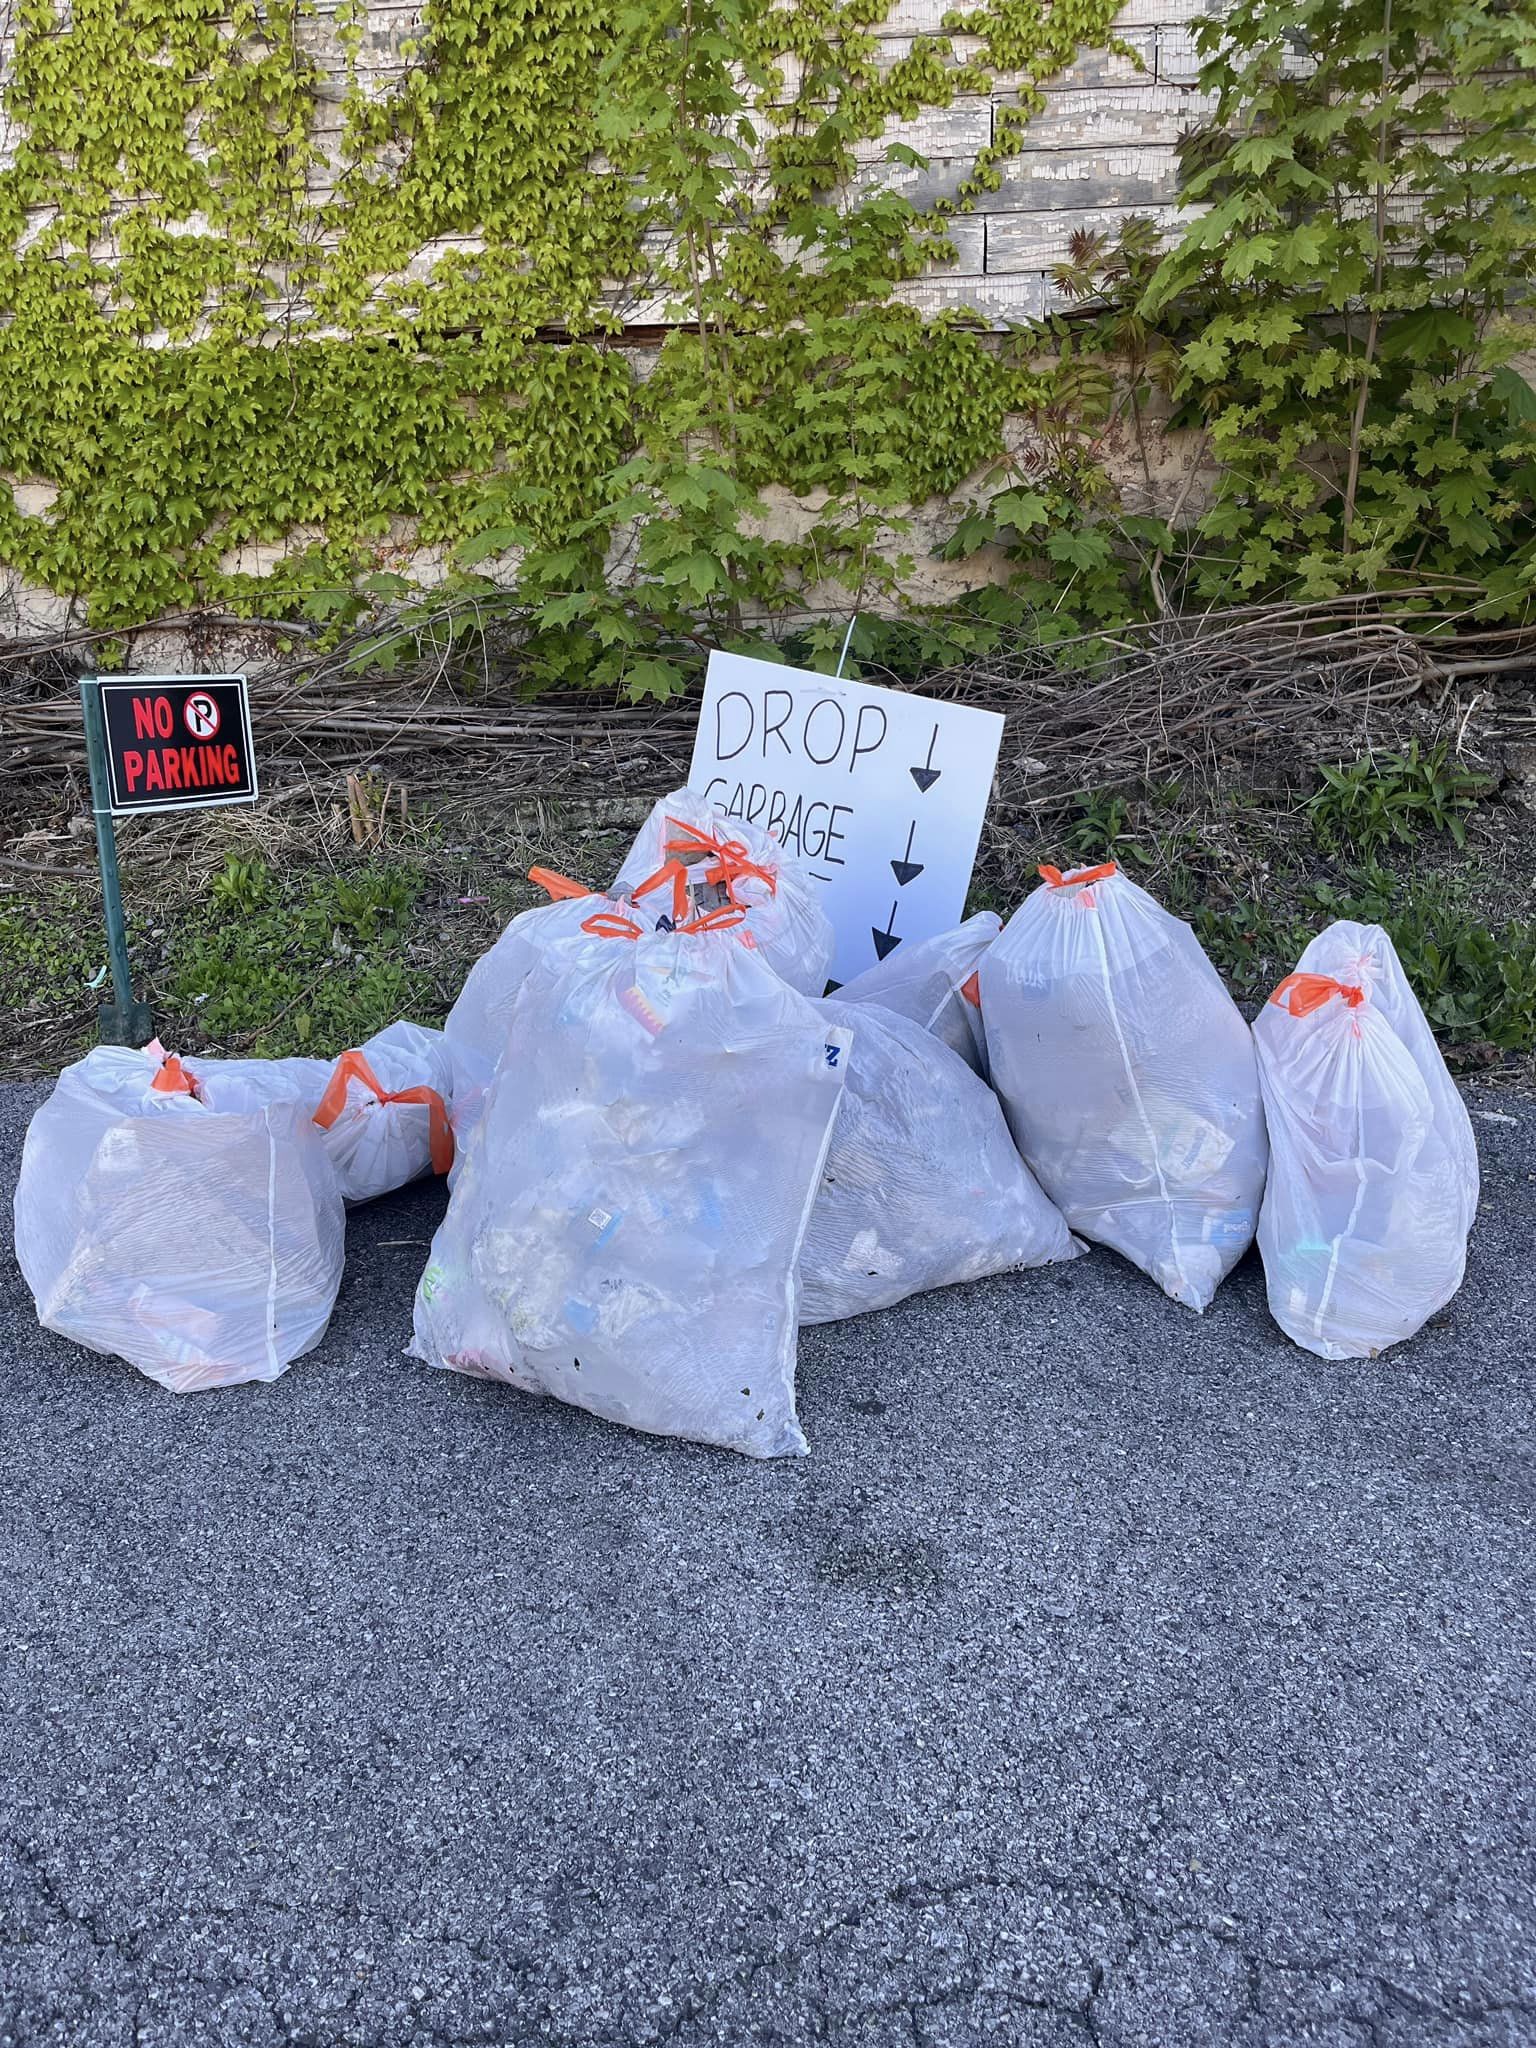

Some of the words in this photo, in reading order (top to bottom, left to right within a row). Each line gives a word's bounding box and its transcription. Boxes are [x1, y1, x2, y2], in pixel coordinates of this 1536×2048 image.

[132, 696, 174, 740] NO
[716, 690, 888, 773] DROP
[123, 744, 240, 792] PARKING
[704, 778, 854, 866] GARBAGE
